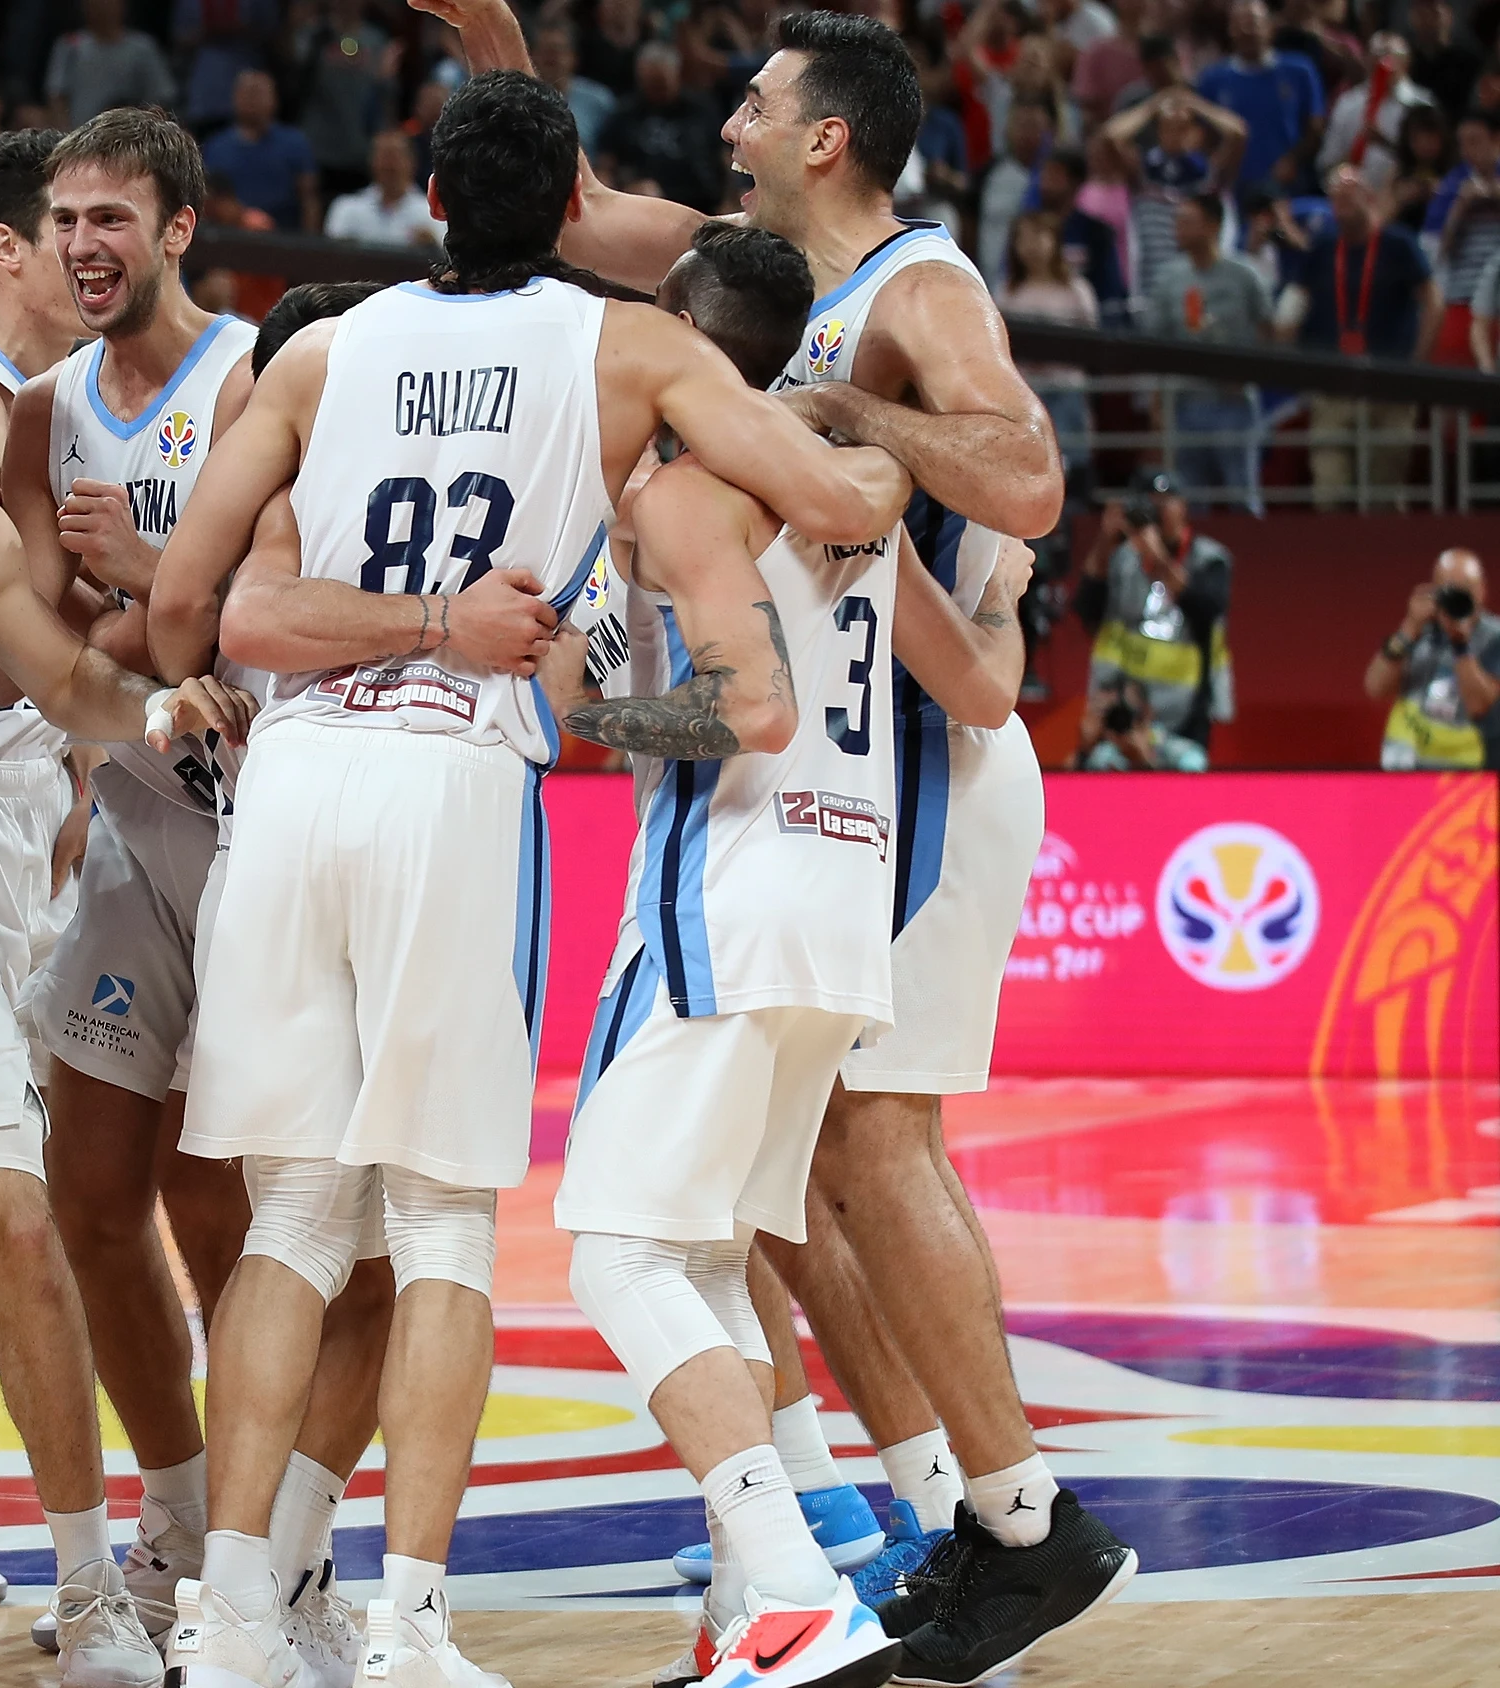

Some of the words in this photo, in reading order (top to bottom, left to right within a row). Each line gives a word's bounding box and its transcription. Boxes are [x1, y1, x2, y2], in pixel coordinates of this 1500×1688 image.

[395, 366, 518, 436] GALLIZZI
[361, 471, 515, 595] 83
[825, 596, 877, 756] 3
[352, 685, 375, 706] la
[822, 795, 853, 809] GRUPO
[823, 810, 842, 834] la
[67, 1009, 88, 1023] PAN
[89, 1018, 140, 1040] AMERICAN
[83, 1026, 121, 1043] SILVER
[63, 1028, 135, 1058] ARGENTINA
